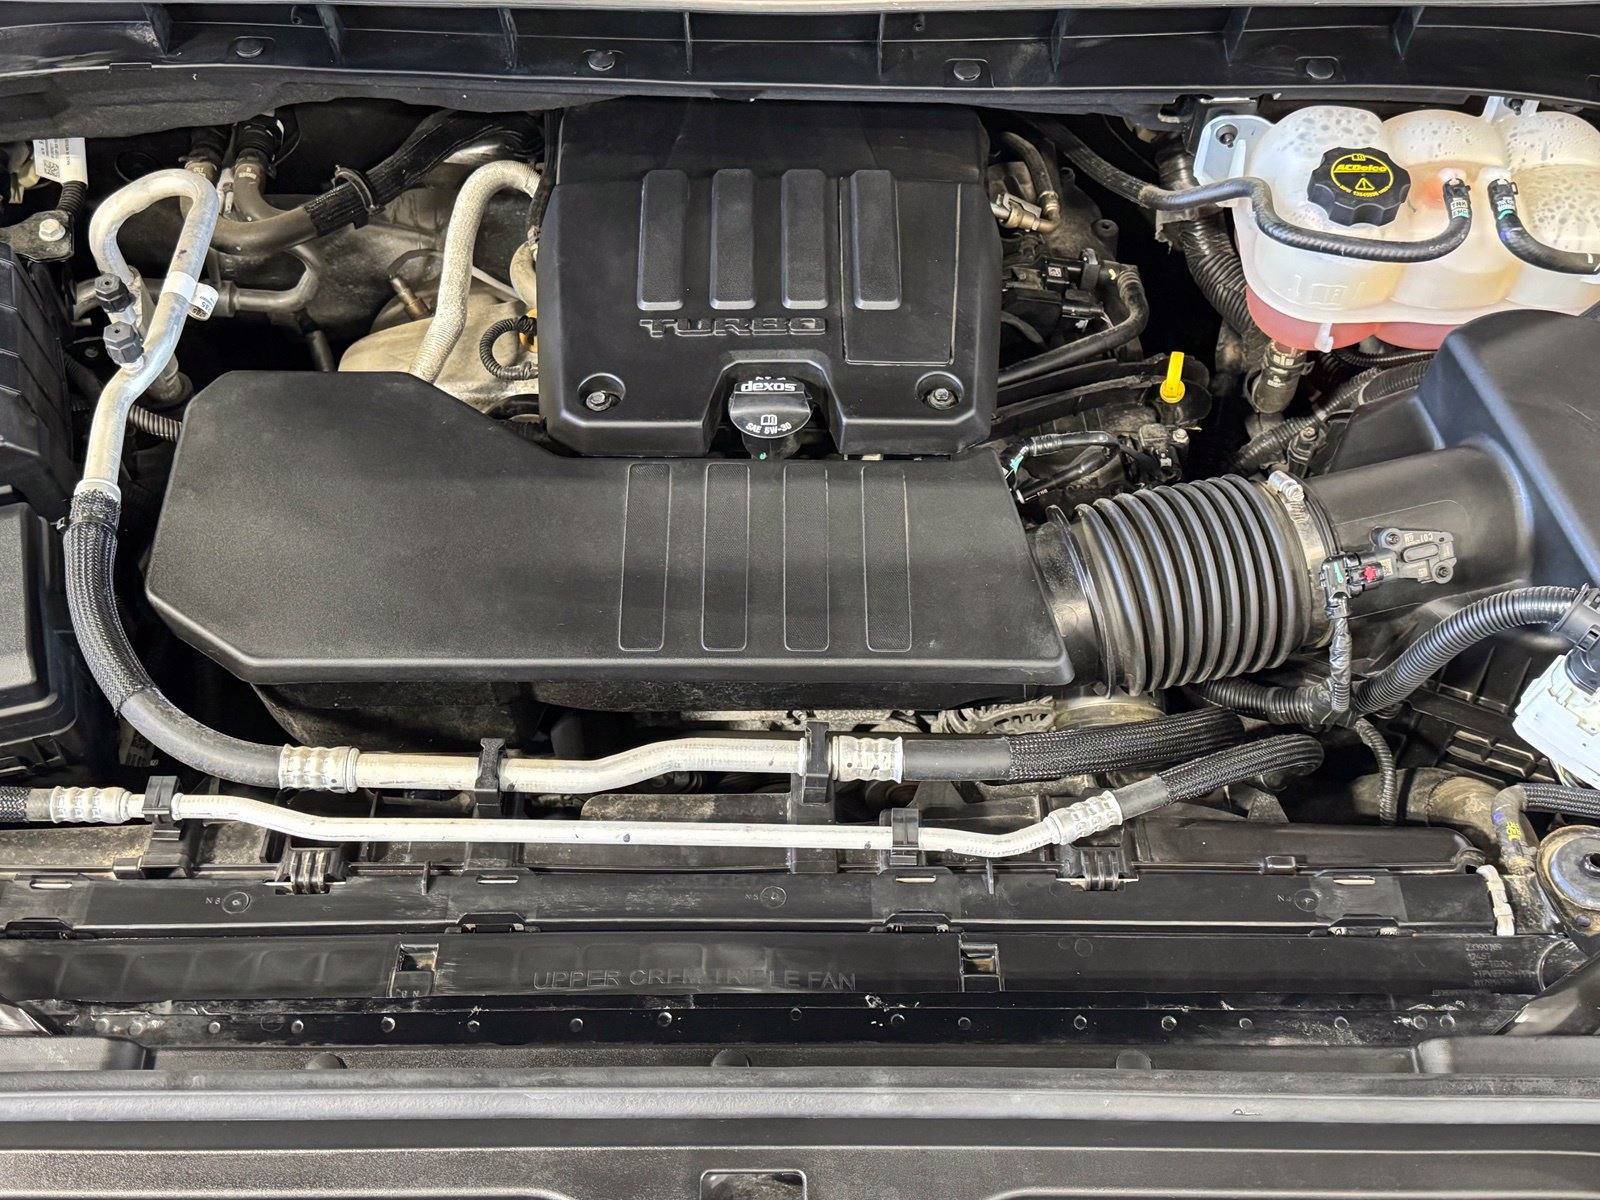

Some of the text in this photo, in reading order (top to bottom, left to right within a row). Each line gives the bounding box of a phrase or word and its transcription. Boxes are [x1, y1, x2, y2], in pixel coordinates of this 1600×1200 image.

[1334, 163, 1388, 172] ACDelco
[638, 317, 827, 338] TURBO
[740, 380, 798, 392] dexos
[745, 421, 792, 435] SAE 5W-30
[533, 970, 621, 990] UPPER
[807, 972, 857, 991] FAN
